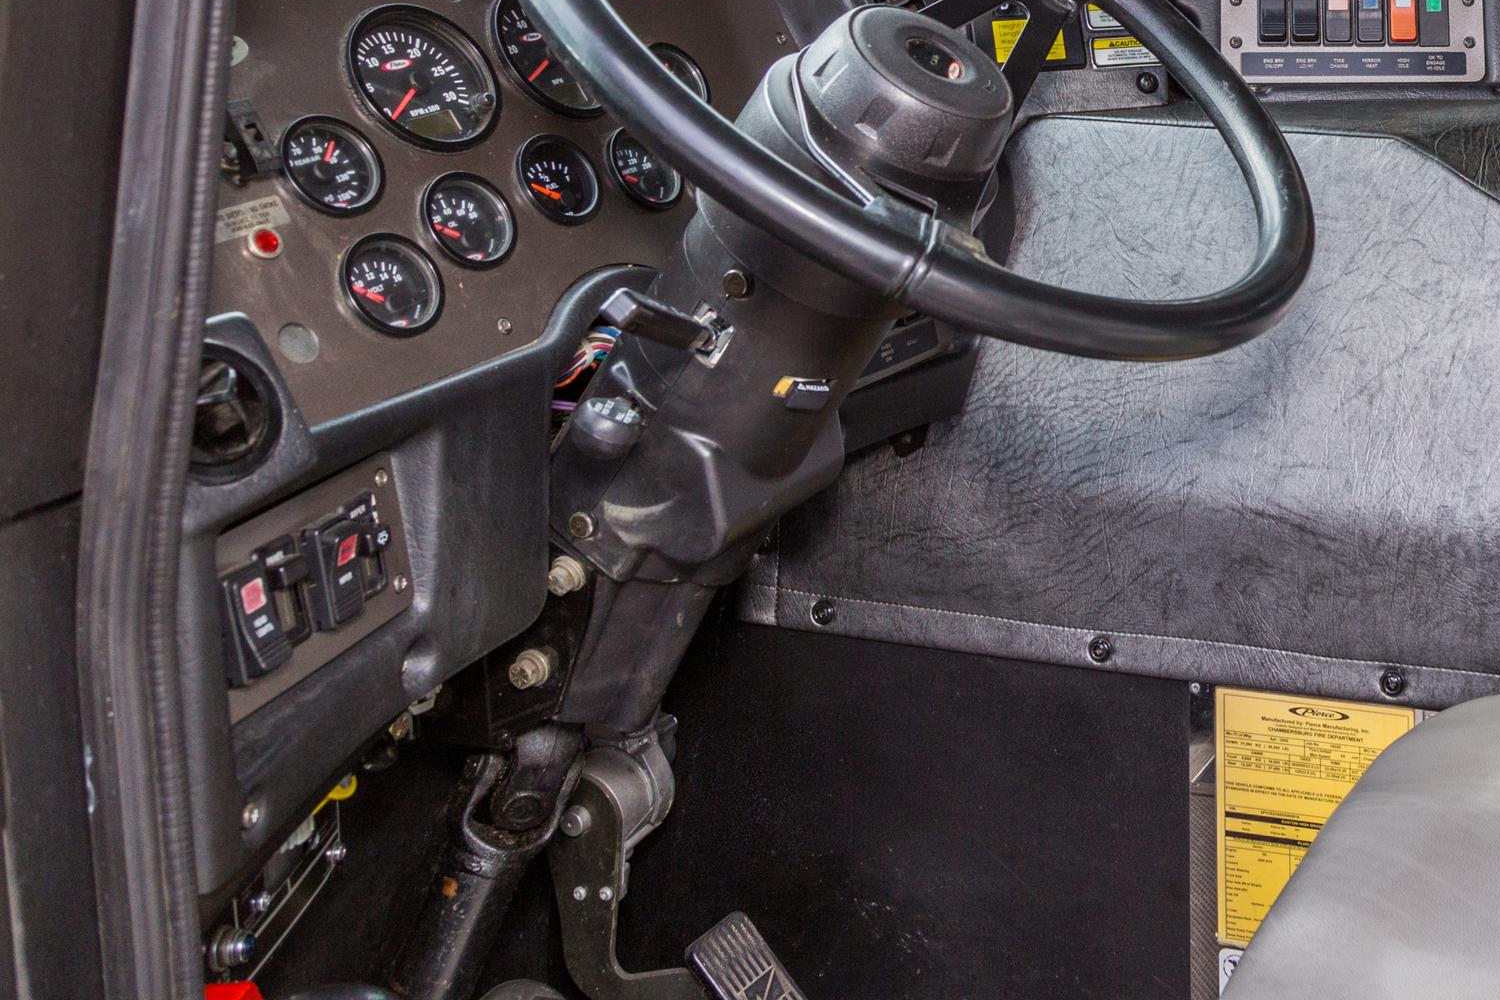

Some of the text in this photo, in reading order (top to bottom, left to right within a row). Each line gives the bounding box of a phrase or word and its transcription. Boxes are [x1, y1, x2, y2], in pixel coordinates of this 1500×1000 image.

[381, 44, 396, 55] 15
[407, 48, 422, 59] 20
[507, 44, 519, 55] 20
[365, 56, 380, 68] 10
[431, 66, 446, 77] 25
[365, 82, 375, 93] 5
[442, 91, 458, 102] 30
[366, 272, 375, 281] 12
[379, 272, 390, 281] 14
[1260, 716, 1295, 725] Manufactured
[1268, 726, 1312, 737] CHAMBERSBURG
[1327, 733, 1364, 743] DEPARTMENT
